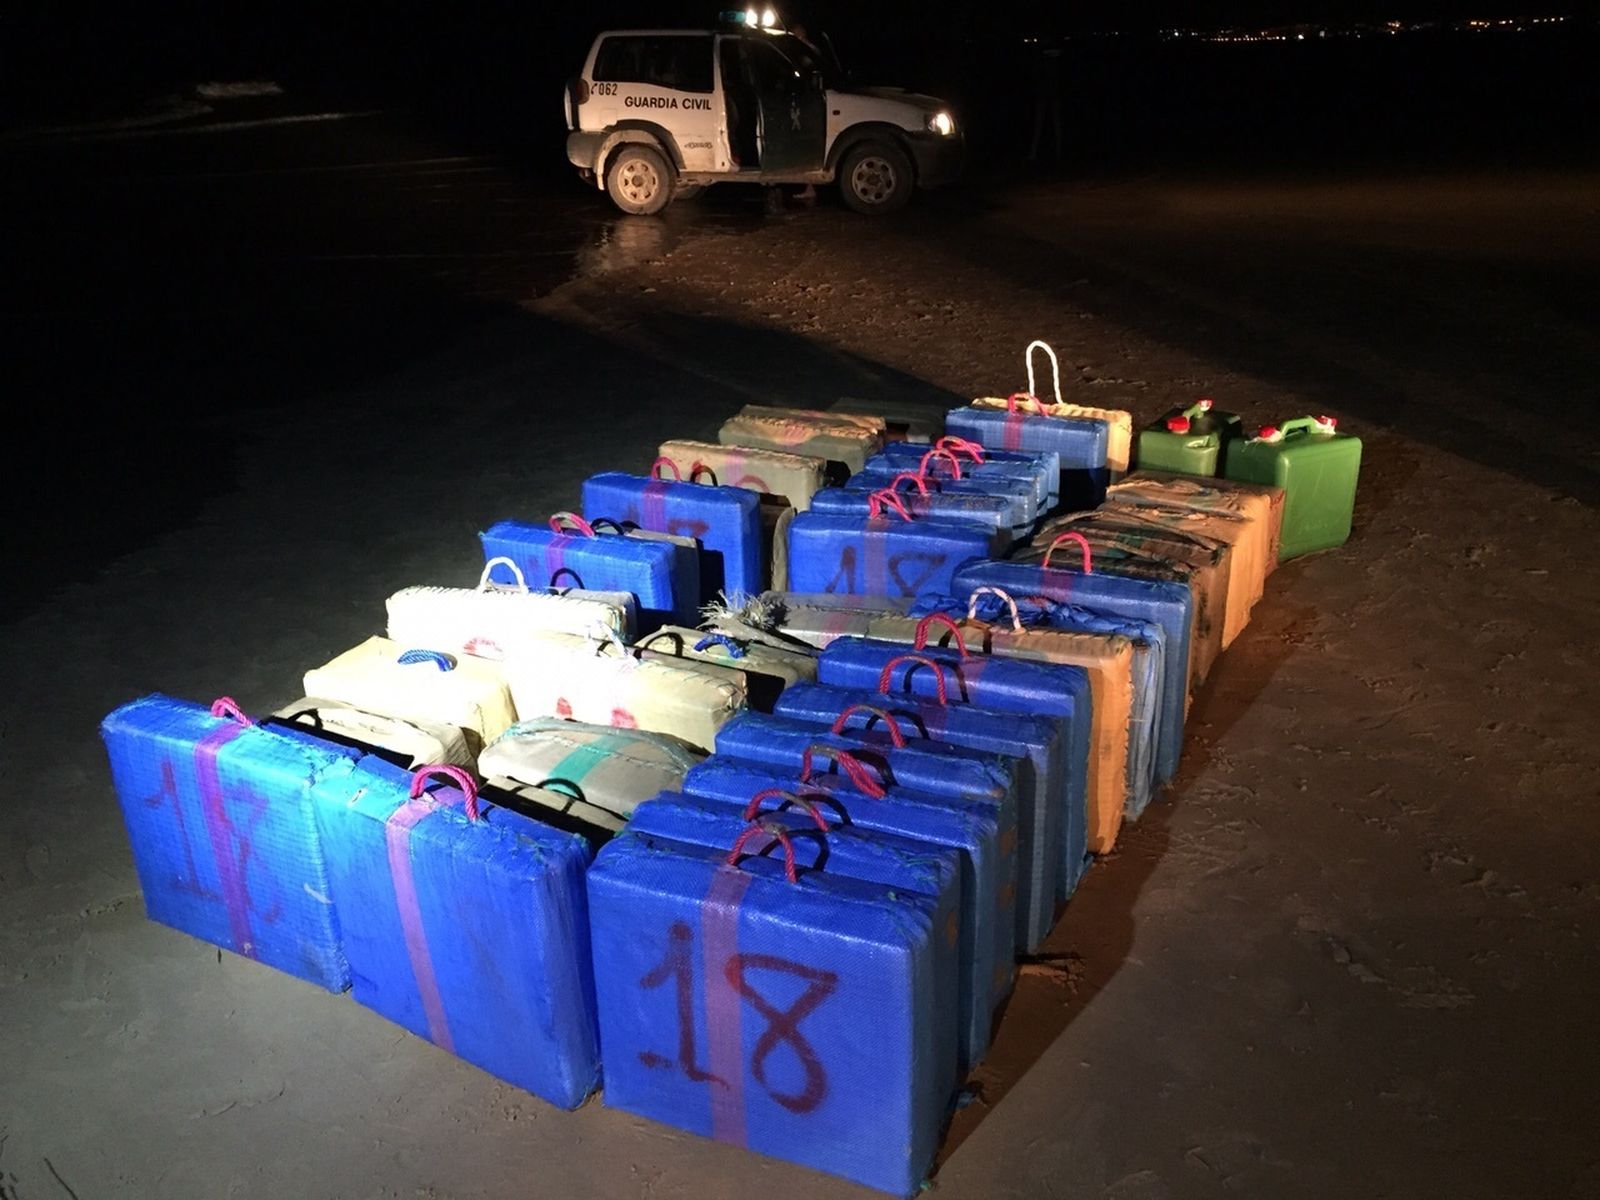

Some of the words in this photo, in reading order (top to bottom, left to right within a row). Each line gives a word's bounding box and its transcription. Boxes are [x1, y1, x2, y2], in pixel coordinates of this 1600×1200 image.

[598, 83, 618, 96] 062
[624, 96, 678, 109] GUARDIA
[682, 98, 712, 111] CIVIL
[637, 919, 840, 1114] 18
